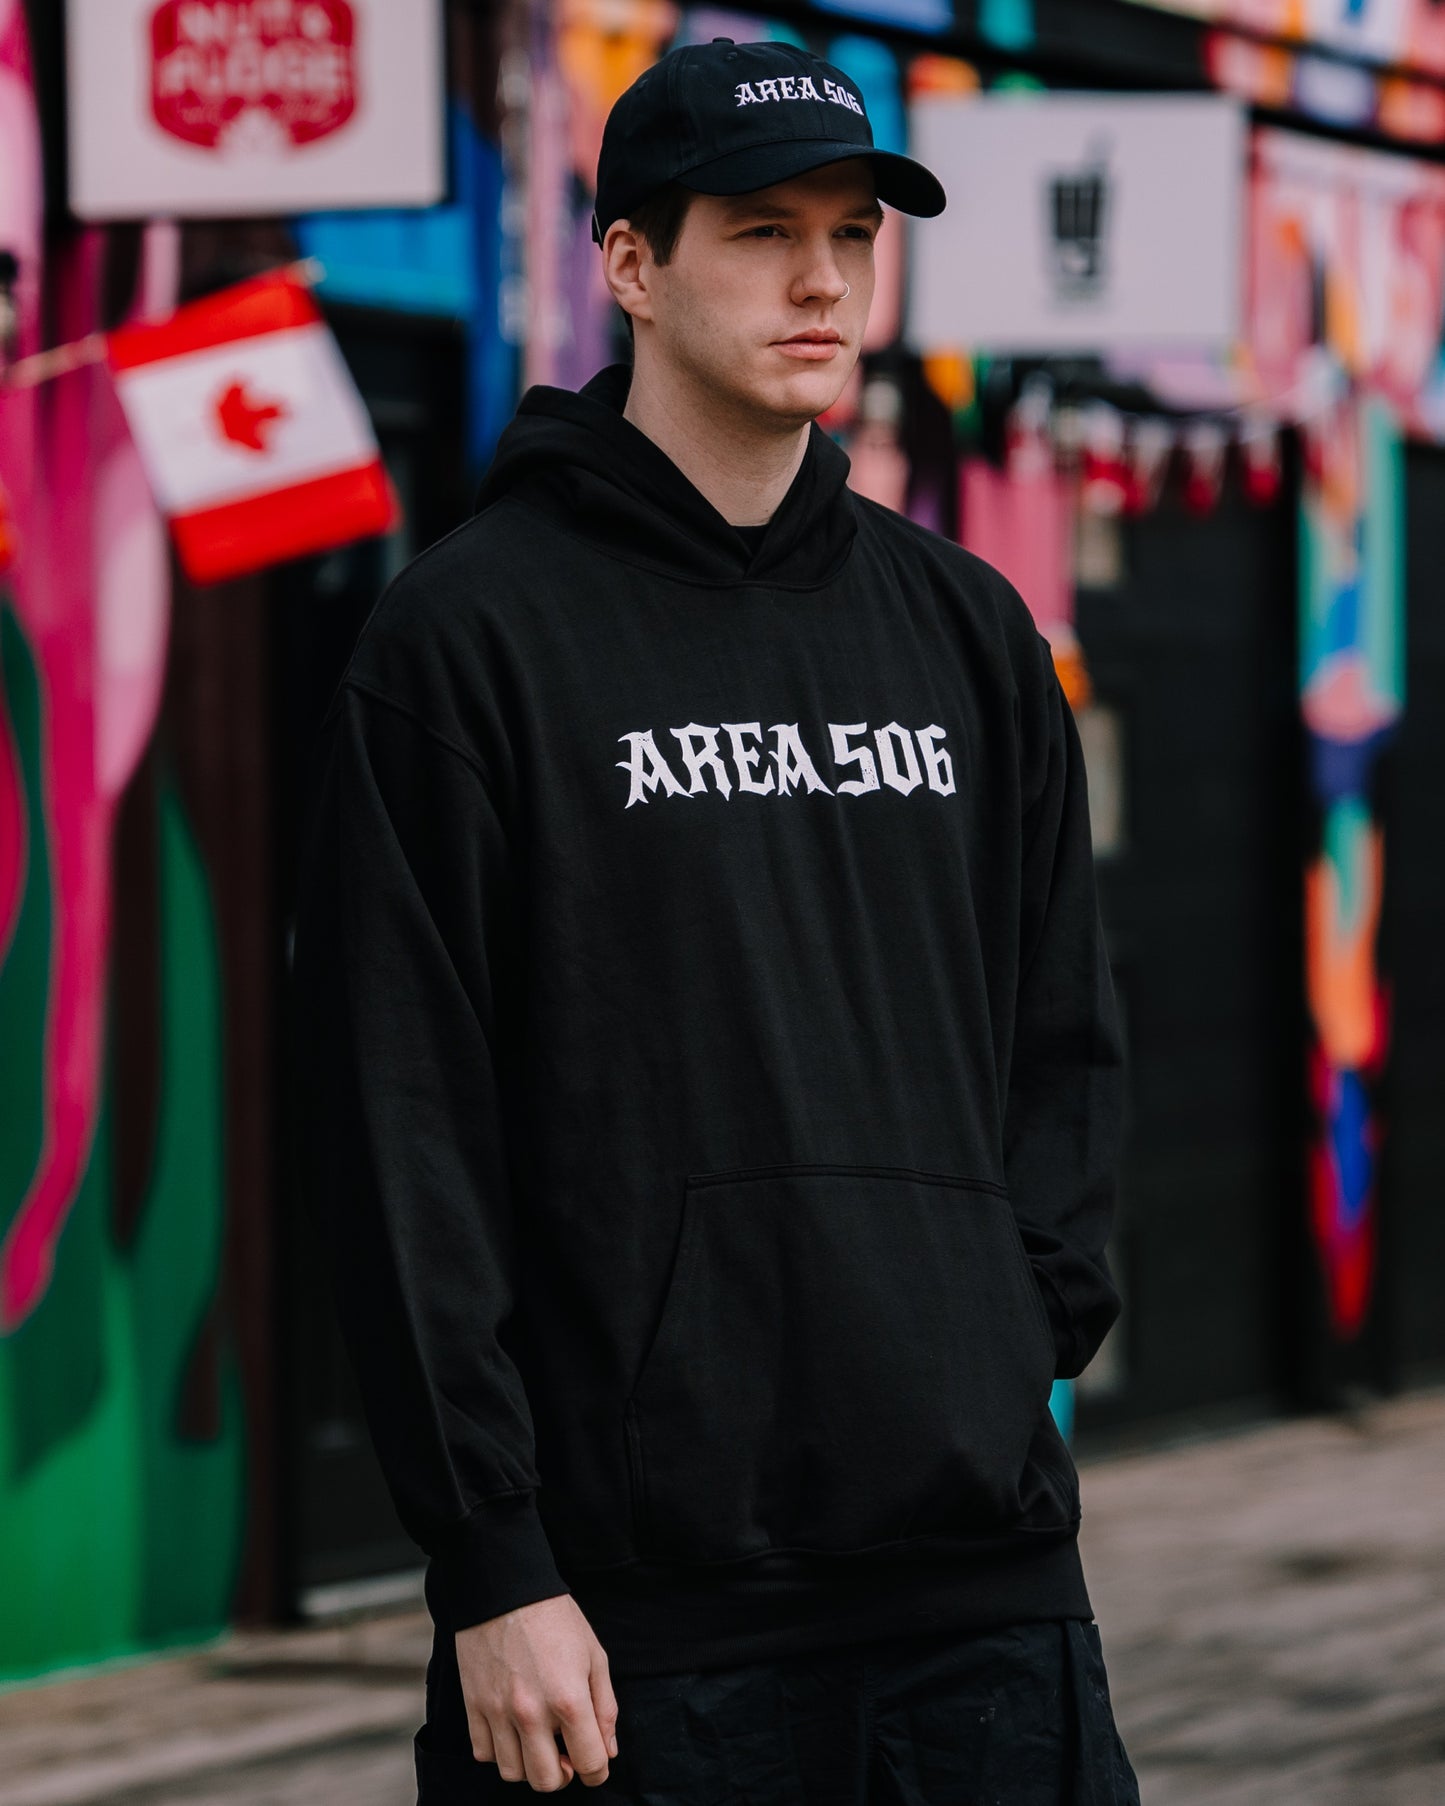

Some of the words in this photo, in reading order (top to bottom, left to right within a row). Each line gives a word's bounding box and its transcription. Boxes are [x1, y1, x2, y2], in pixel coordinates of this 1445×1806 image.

[734, 76, 826, 107] AREA
[823, 78, 864, 116] 506
[615, 722, 835, 809] AREA
[828, 721, 956, 797] 506
